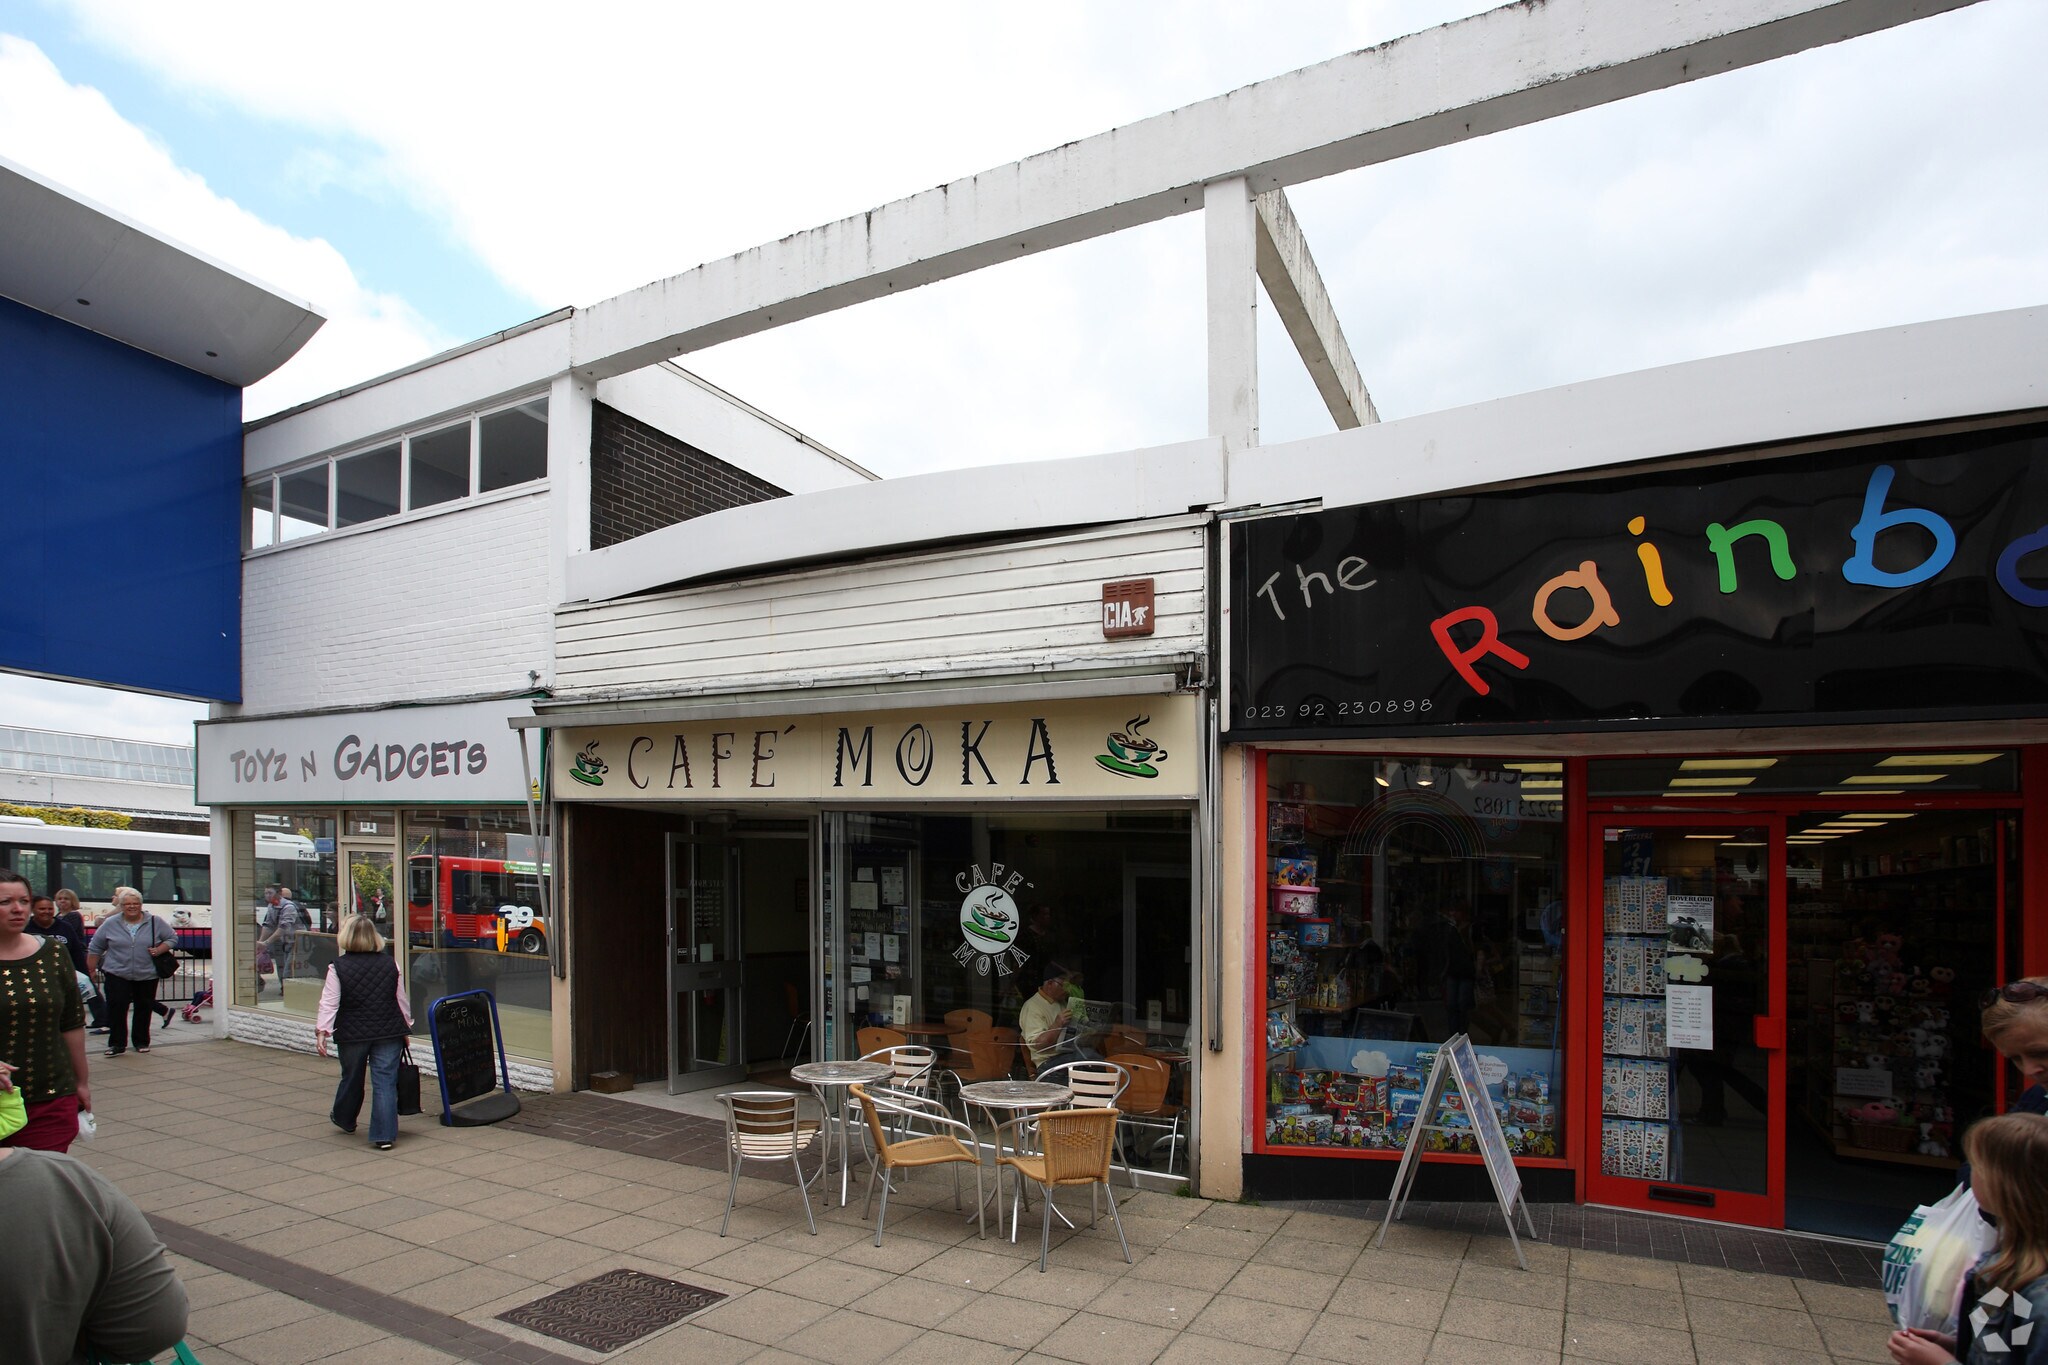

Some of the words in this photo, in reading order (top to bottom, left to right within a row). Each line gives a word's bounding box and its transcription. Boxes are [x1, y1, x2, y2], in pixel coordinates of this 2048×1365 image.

[1256, 556, 1378, 620] The
[1104, 601, 1132, 629] CIA
[1246, 705, 1286, 718] 023
[1299, 703, 1325, 716] 92
[1338, 698, 1433, 714] 230898
[301, 750, 317, 782] N
[333, 734, 487, 783] GADGETS
[833, 718, 1061, 786] MOKA
[298, 849, 316, 858] First
[499, 904, 534, 928] 39
[952, 941, 1030, 977] MOKA
